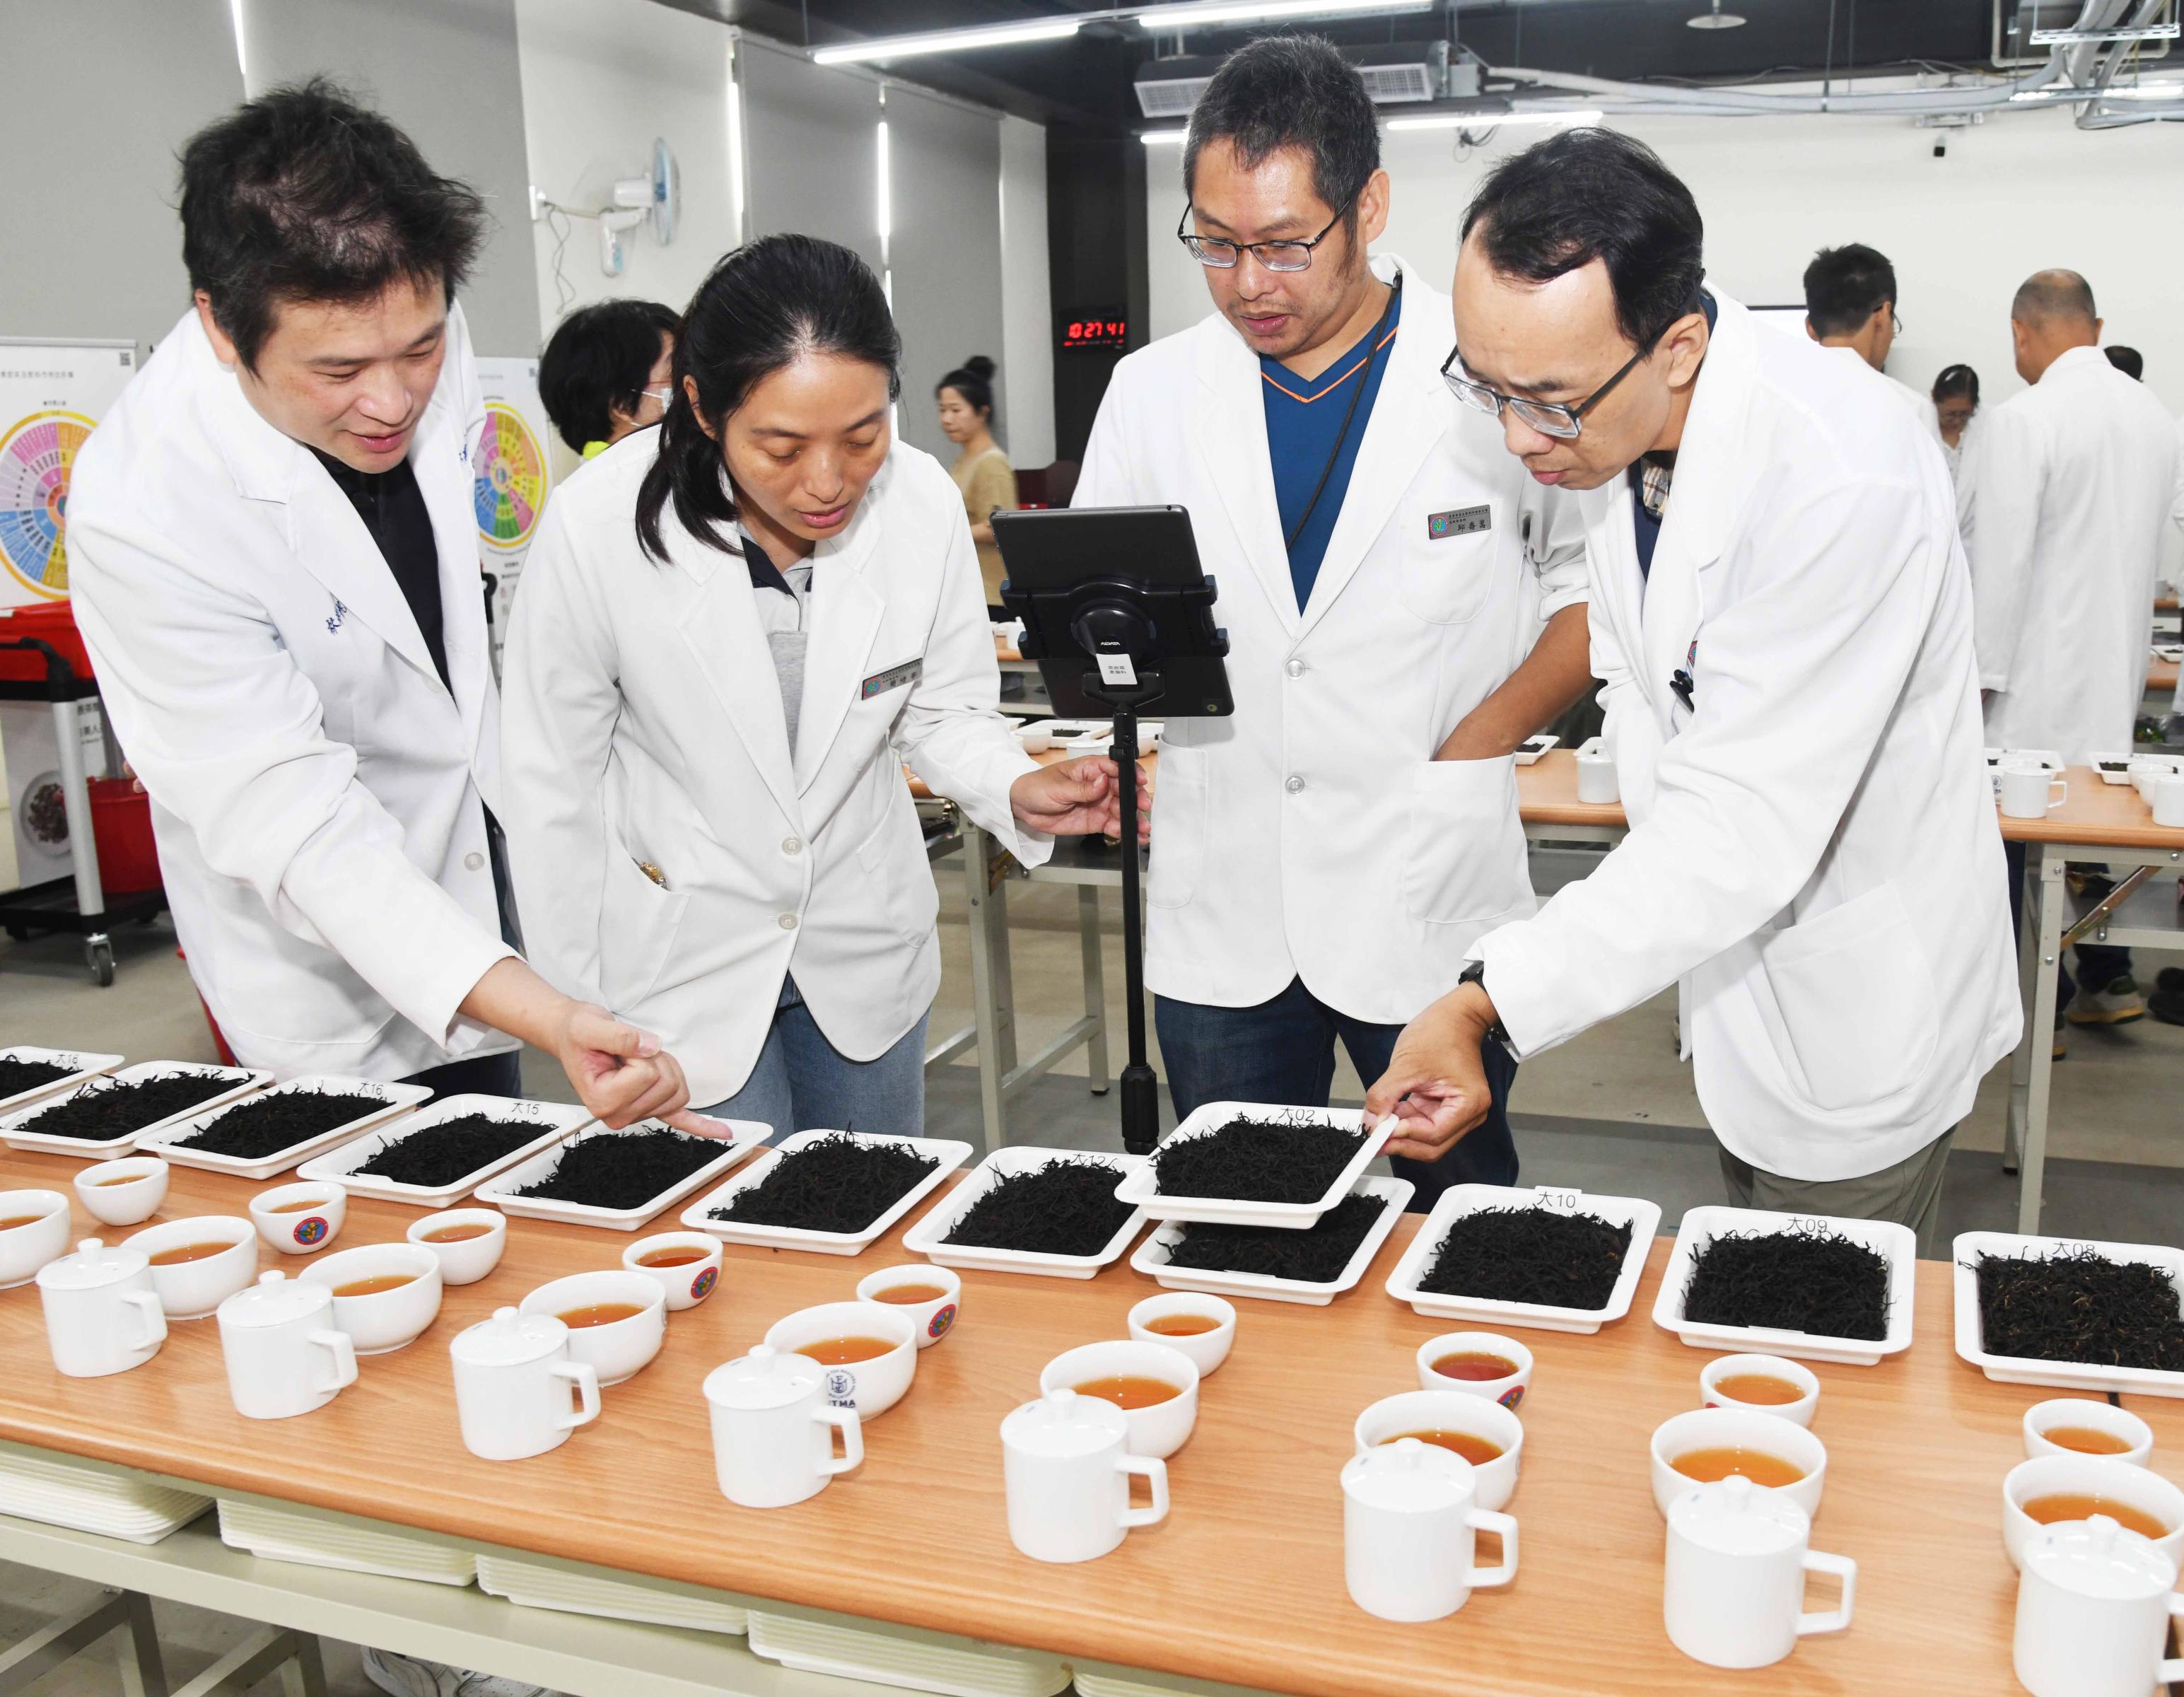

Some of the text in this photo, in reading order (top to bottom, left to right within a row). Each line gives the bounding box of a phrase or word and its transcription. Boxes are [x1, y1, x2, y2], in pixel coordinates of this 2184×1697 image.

[358, 1081, 384, 1095] 大16
[511, 1102, 541, 1115] 大15
[1278, 1107, 1315, 1122] 大02
[1536, 1191, 1576, 1208] 大10
[1786, 1217, 1828, 1233] 大09
[2052, 1241, 2096, 1259] 大08
